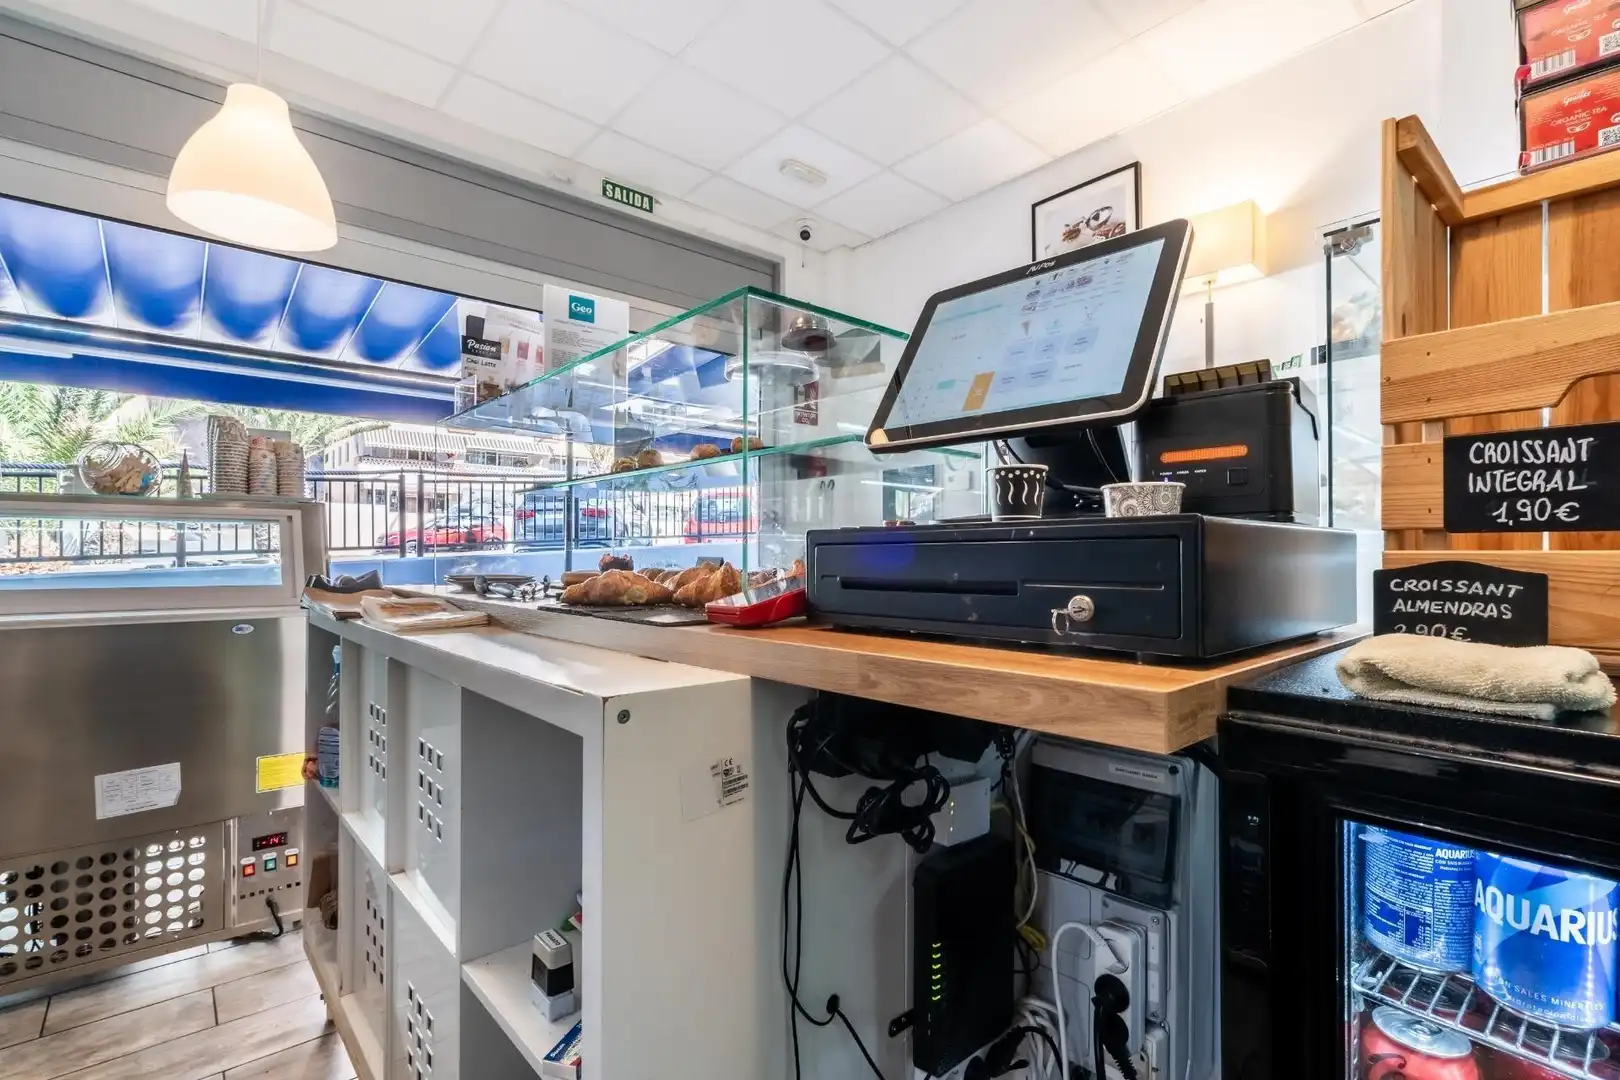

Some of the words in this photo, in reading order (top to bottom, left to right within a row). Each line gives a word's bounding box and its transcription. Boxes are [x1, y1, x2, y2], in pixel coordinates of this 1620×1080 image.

[1592, 106, 1608, 115] TEA
[605, 183, 651, 210] SALIDA
[571, 302, 593, 314] Geo
[1468, 437, 1595, 464] CROISSANT
[1468, 468, 1588, 493] INTEGRAL
[1492, 497, 1580, 525] 1,90€
[1389, 578, 1523, 598] CROISSANT
[1392, 598, 1513, 620] ALMENDRAS
[1394, 623, 1471, 642] 290€
[1514, 985, 1547, 1003] SALES
